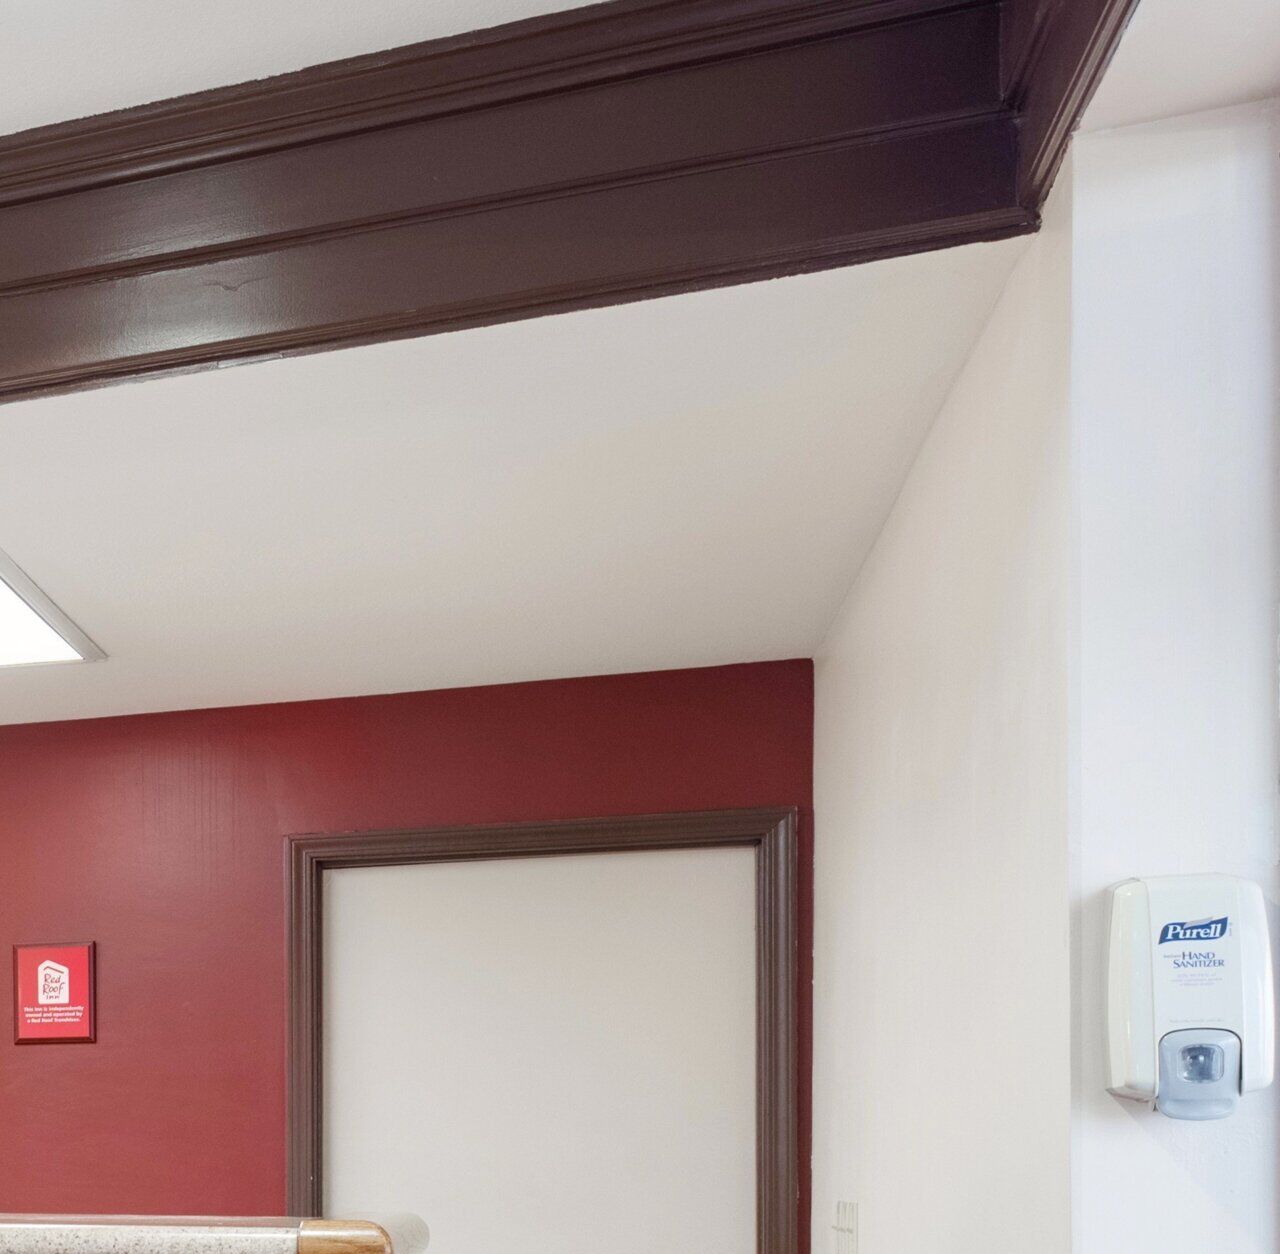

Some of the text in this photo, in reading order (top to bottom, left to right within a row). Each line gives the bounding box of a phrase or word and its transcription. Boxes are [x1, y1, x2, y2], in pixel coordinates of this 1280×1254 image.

[1165, 923, 1222, 940] Purell
[44, 973, 61, 984] Red
[43, 981, 65, 996] Roof
